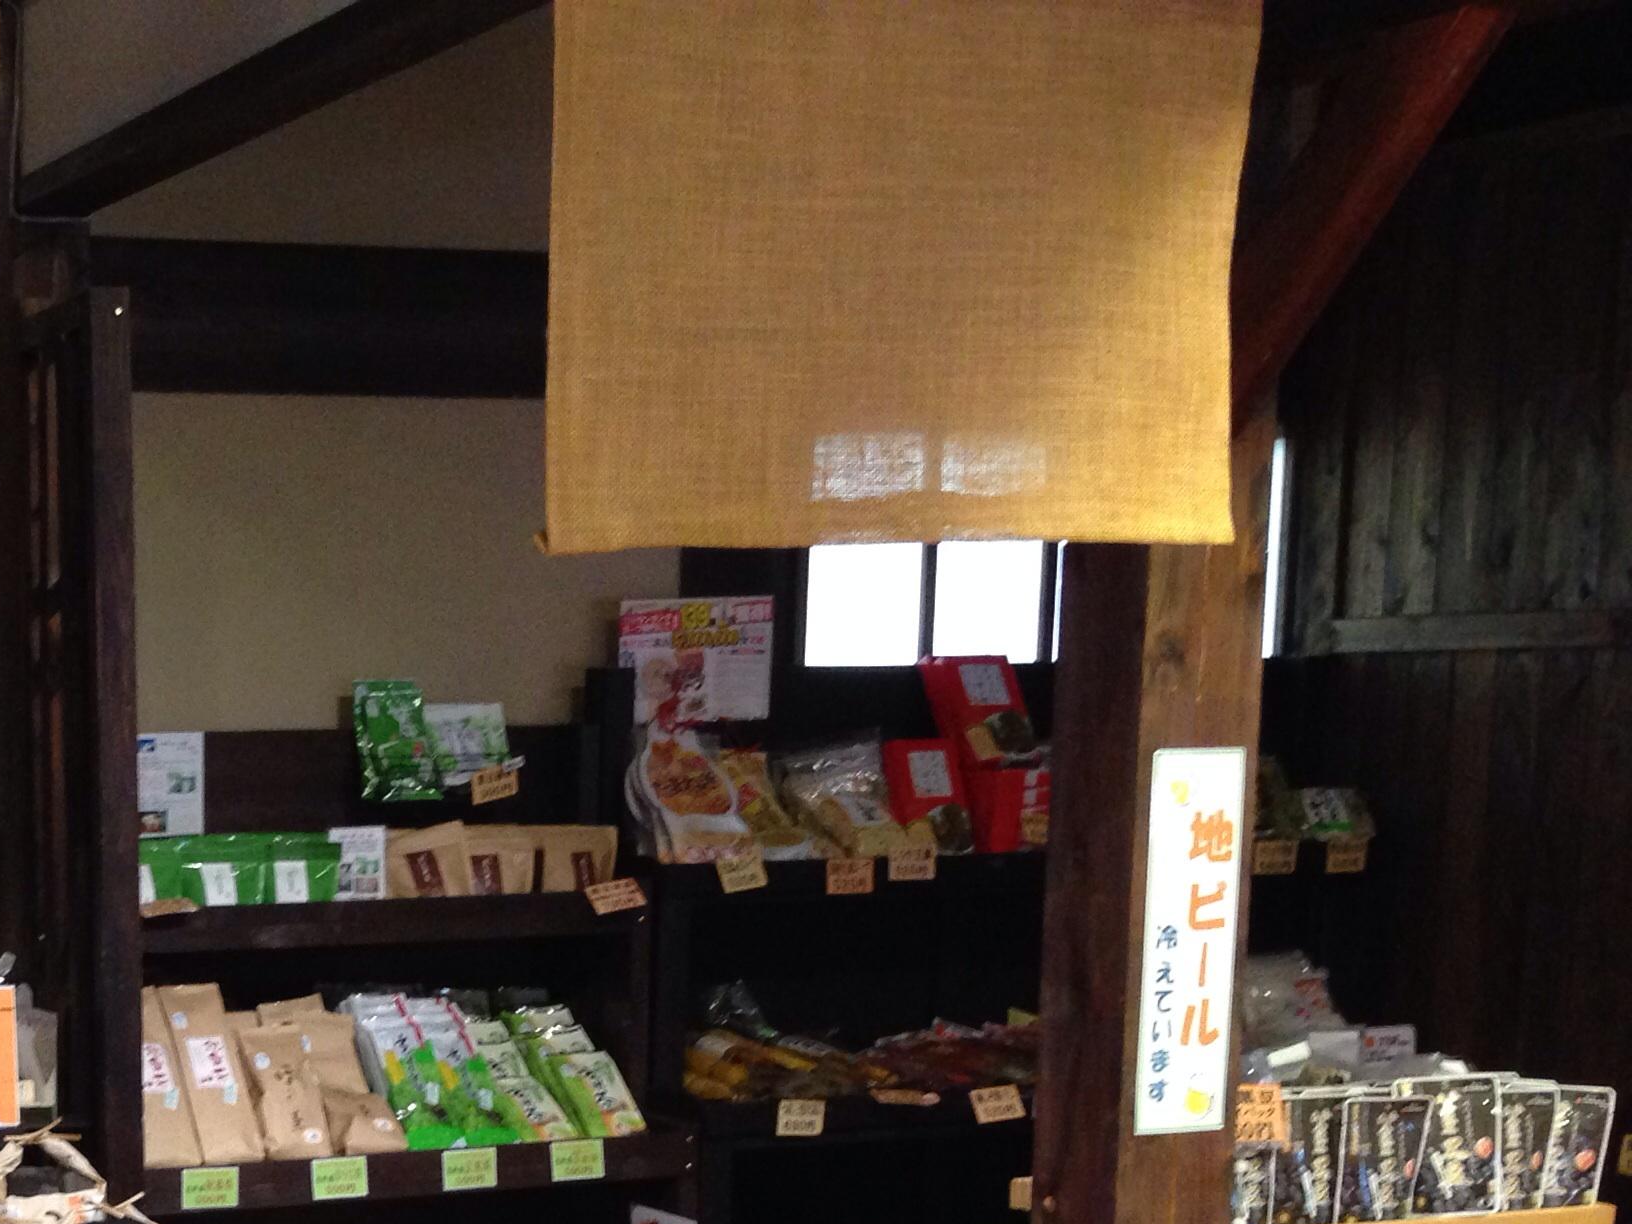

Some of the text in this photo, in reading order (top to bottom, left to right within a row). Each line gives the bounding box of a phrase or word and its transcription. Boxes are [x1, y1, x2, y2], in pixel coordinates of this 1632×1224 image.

[1147, 924, 1179, 1103] 冷えています
[1179, 808, 1234, 1047] 地ビール
